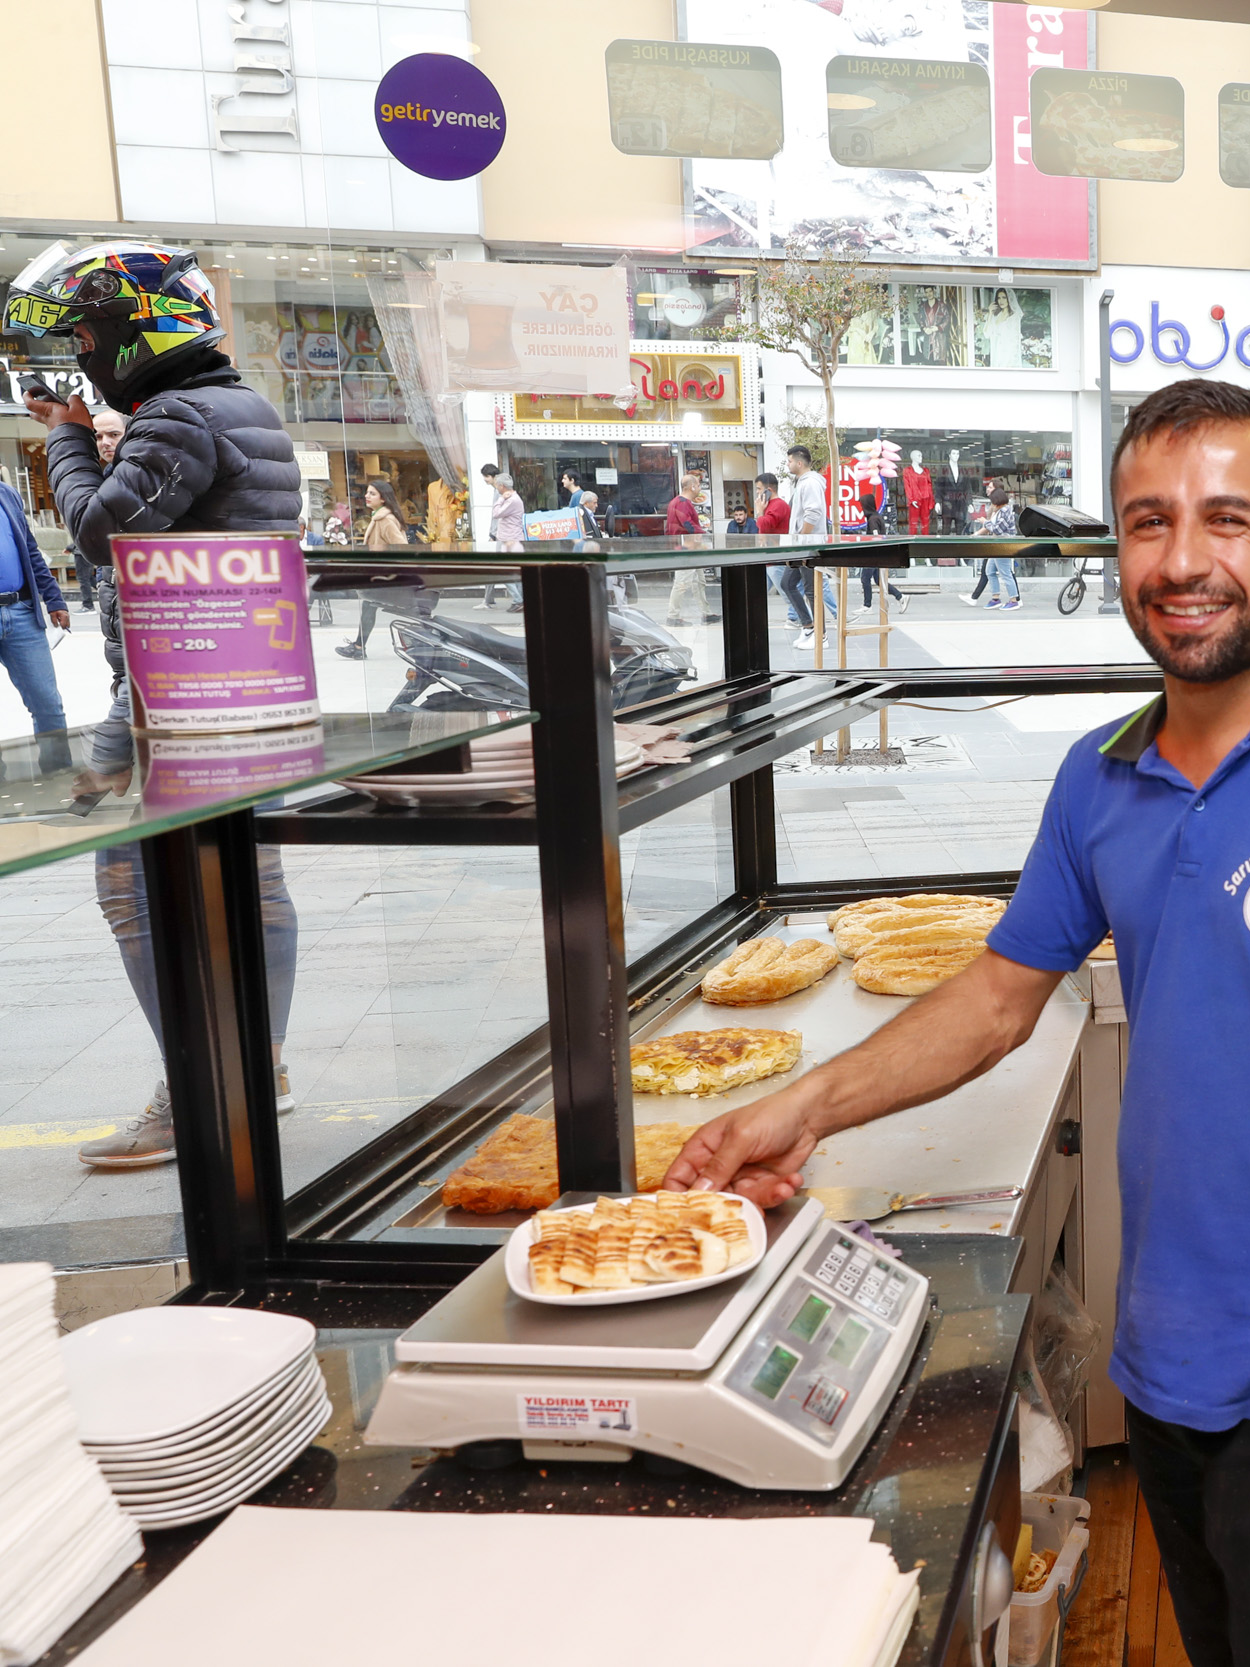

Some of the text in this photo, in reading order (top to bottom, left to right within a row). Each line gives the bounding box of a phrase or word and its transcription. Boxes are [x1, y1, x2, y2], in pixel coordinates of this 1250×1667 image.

[127, 551, 211, 585] CAN
[218, 549, 281, 585] OL!
[524, 1396, 630, 1408] YILDIRIM TARTI
